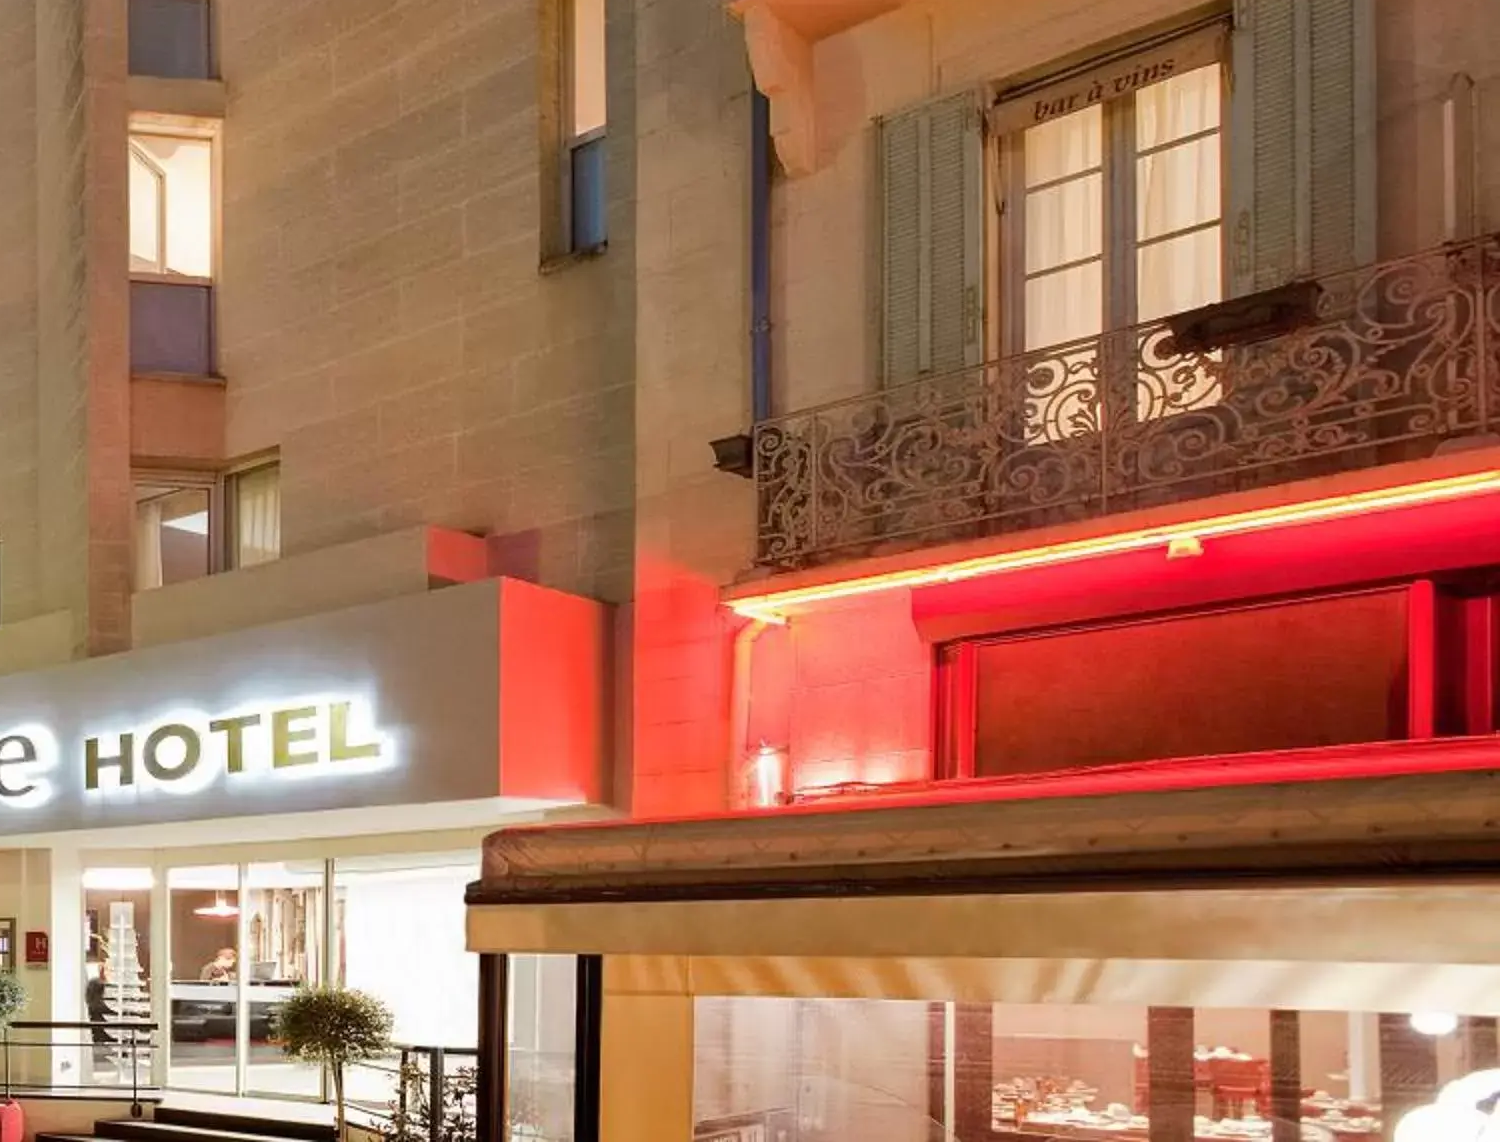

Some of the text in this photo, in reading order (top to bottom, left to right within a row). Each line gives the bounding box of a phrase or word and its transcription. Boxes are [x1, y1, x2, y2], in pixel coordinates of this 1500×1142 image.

[1033, 58, 1176, 122] bar à vins
[85, 700, 382, 791] HOTEL
